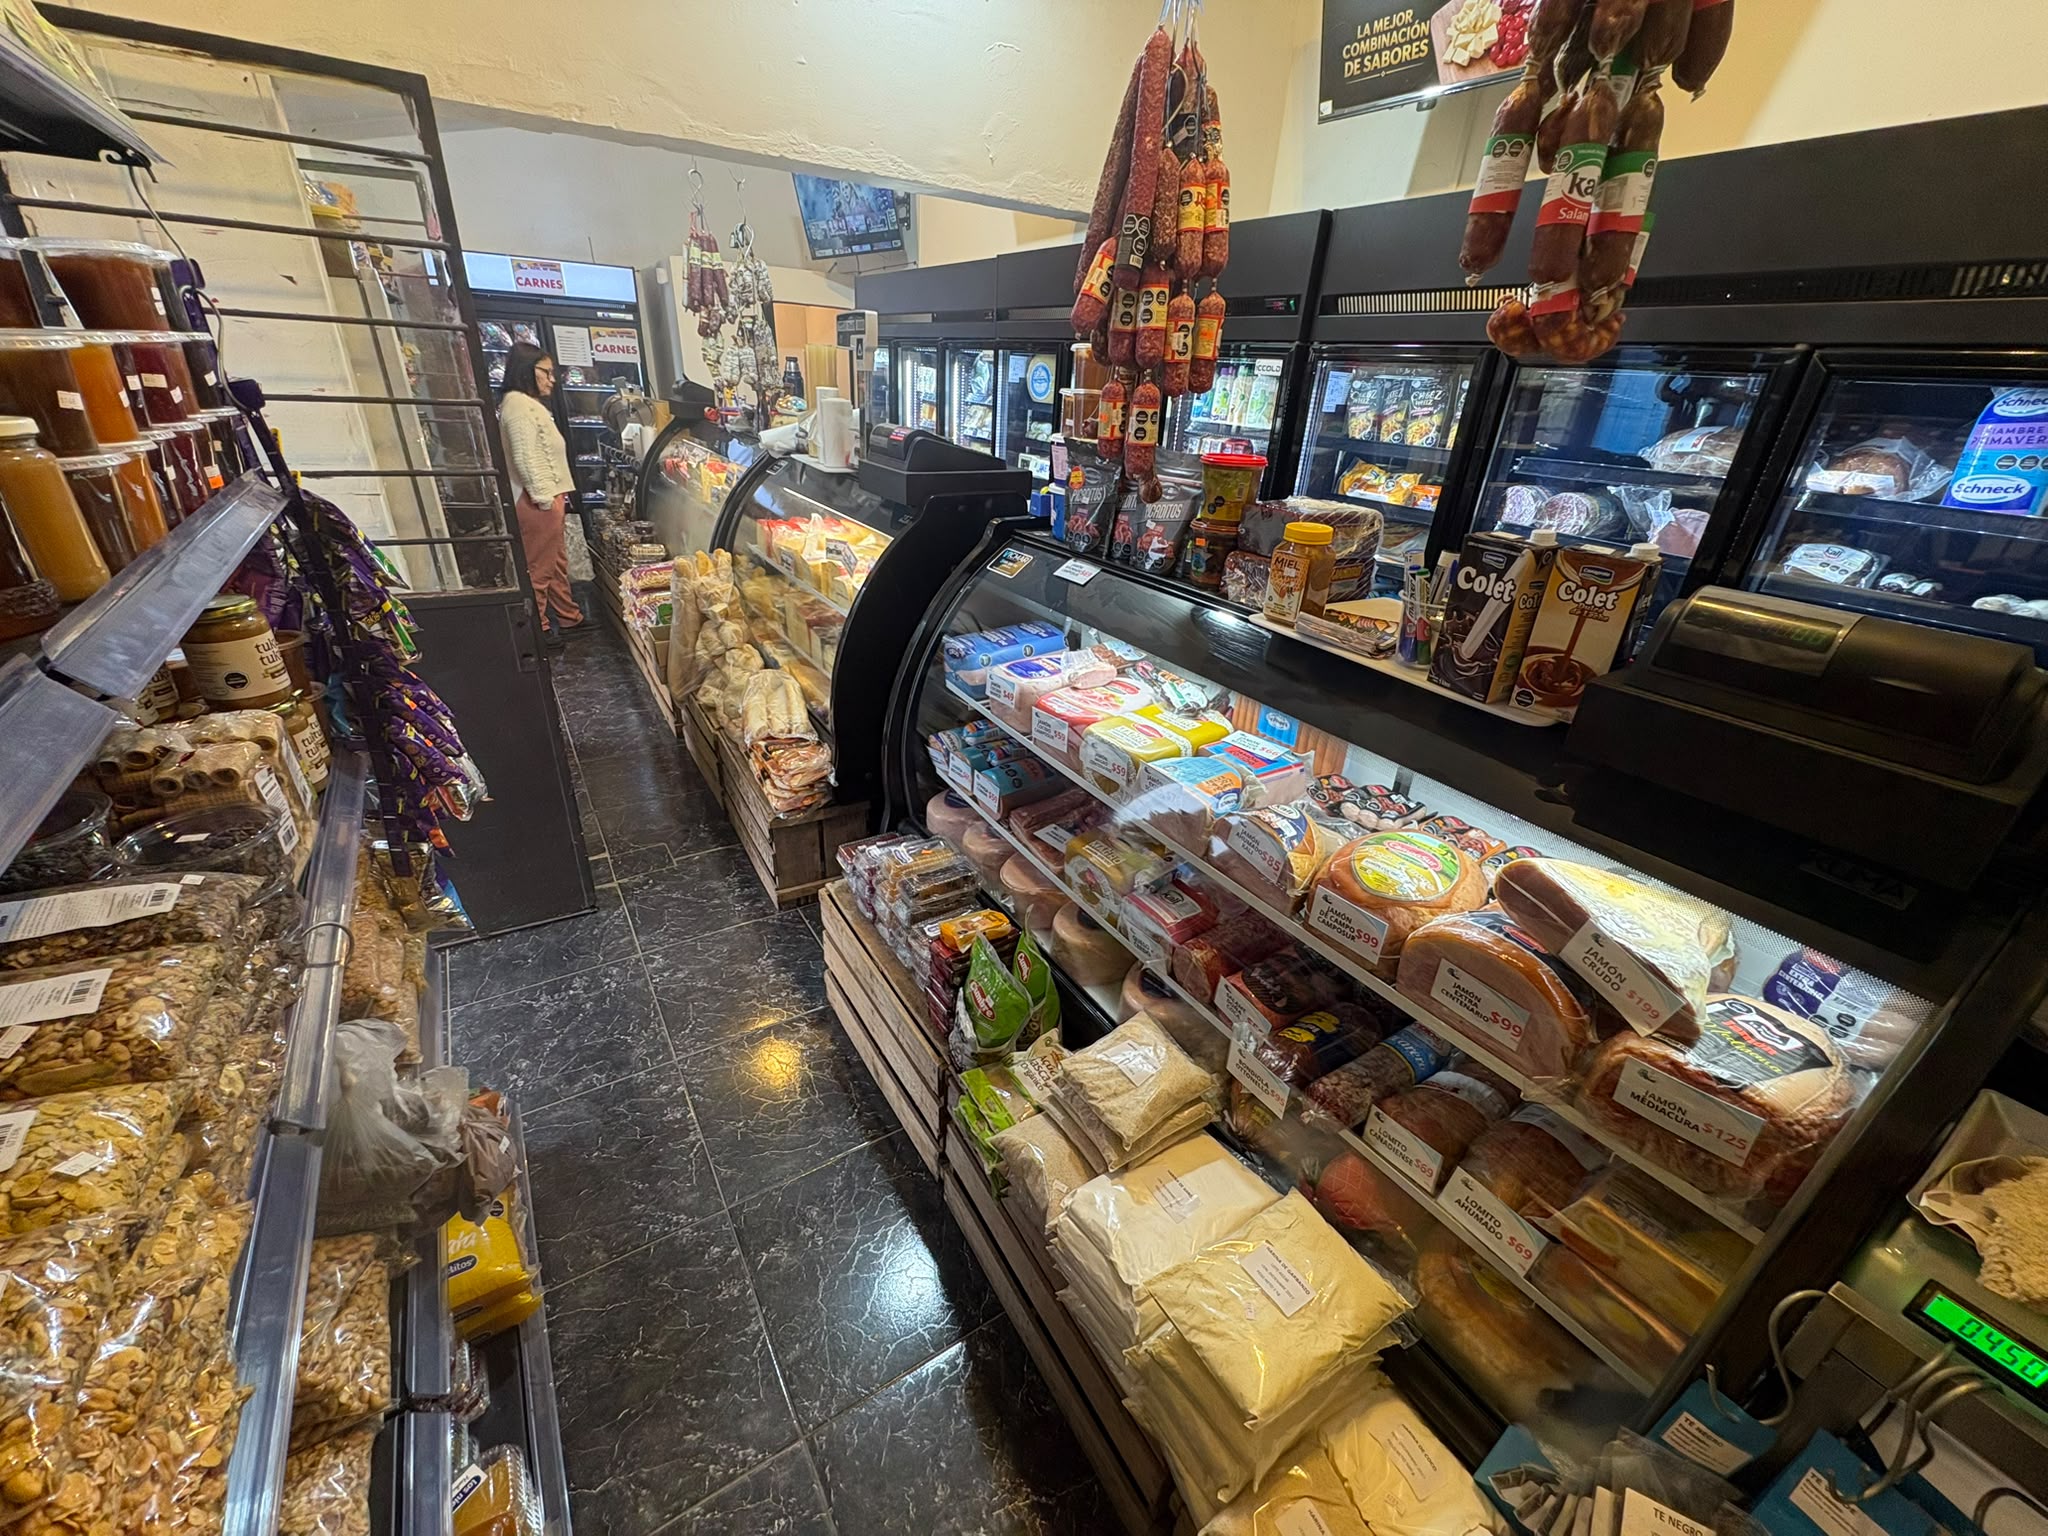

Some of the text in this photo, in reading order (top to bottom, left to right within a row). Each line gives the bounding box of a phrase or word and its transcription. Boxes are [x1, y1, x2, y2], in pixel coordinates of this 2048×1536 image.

[1357, 9, 1414, 39] LA MEJOR
[1342, 19, 1430, 60] COMBINACIÓN
[1344, 39, 1429, 78] DE SABORES
[515, 276, 563, 290] CARNES
[594, 343, 638, 355] CARNES
[1984, 426, 2046, 435] IAMBRE
[1955, 481, 2026, 497] Schneck
[1275, 557, 1300, 571] MIEL
[1457, 566, 1517, 602] Colet
[1558, 580, 1619, 611] Colet
[1111, 762, 1126, 777] $59
[1240, 829, 1260, 846] JAMÓN
[1260, 850, 1282, 872] $85
[1317, 916, 1356, 942] CAMPOSUR
[1319, 909, 1355, 934] DE CAMPO
[1328, 906, 1353, 924] JAMÓN
[1355, 928, 1379, 948] $99
[1581, 955, 1621, 992] CRUDO
[1584, 946, 1627, 984] JAMÓN
[1441, 988, 1489, 1023] CENTENARIO
[1453, 982, 1481, 1003] JAMÓN
[1454, 990, 1479, 1009] EXTRA
[1624, 988, 1660, 1021] $199
[1489, 1010, 1523, 1038] $99
[1235, 1063, 1270, 1096] OTTONELLO
[1238, 1059, 1269, 1088] BONDIOLA
[1629, 1091, 1700, 1133] MEDIACURA
[1643, 1089, 1688, 1117] JAMÓN
[1369, 1128, 1414, 1167] CANADIENSE
[1378, 1126, 1408, 1153] LOMITO
[1701, 1122, 1748, 1151] $125
[1413, 1158, 1434, 1179] $69
[1454, 1198, 1504, 1241] AHUMADO
[1465, 1195, 1502, 1229] LOMITO
[1507, 1235, 1534, 1261] $69
[1308, 1508, 1326, 1536] HARINA
[1653, 1506, 1666, 1523] TE
